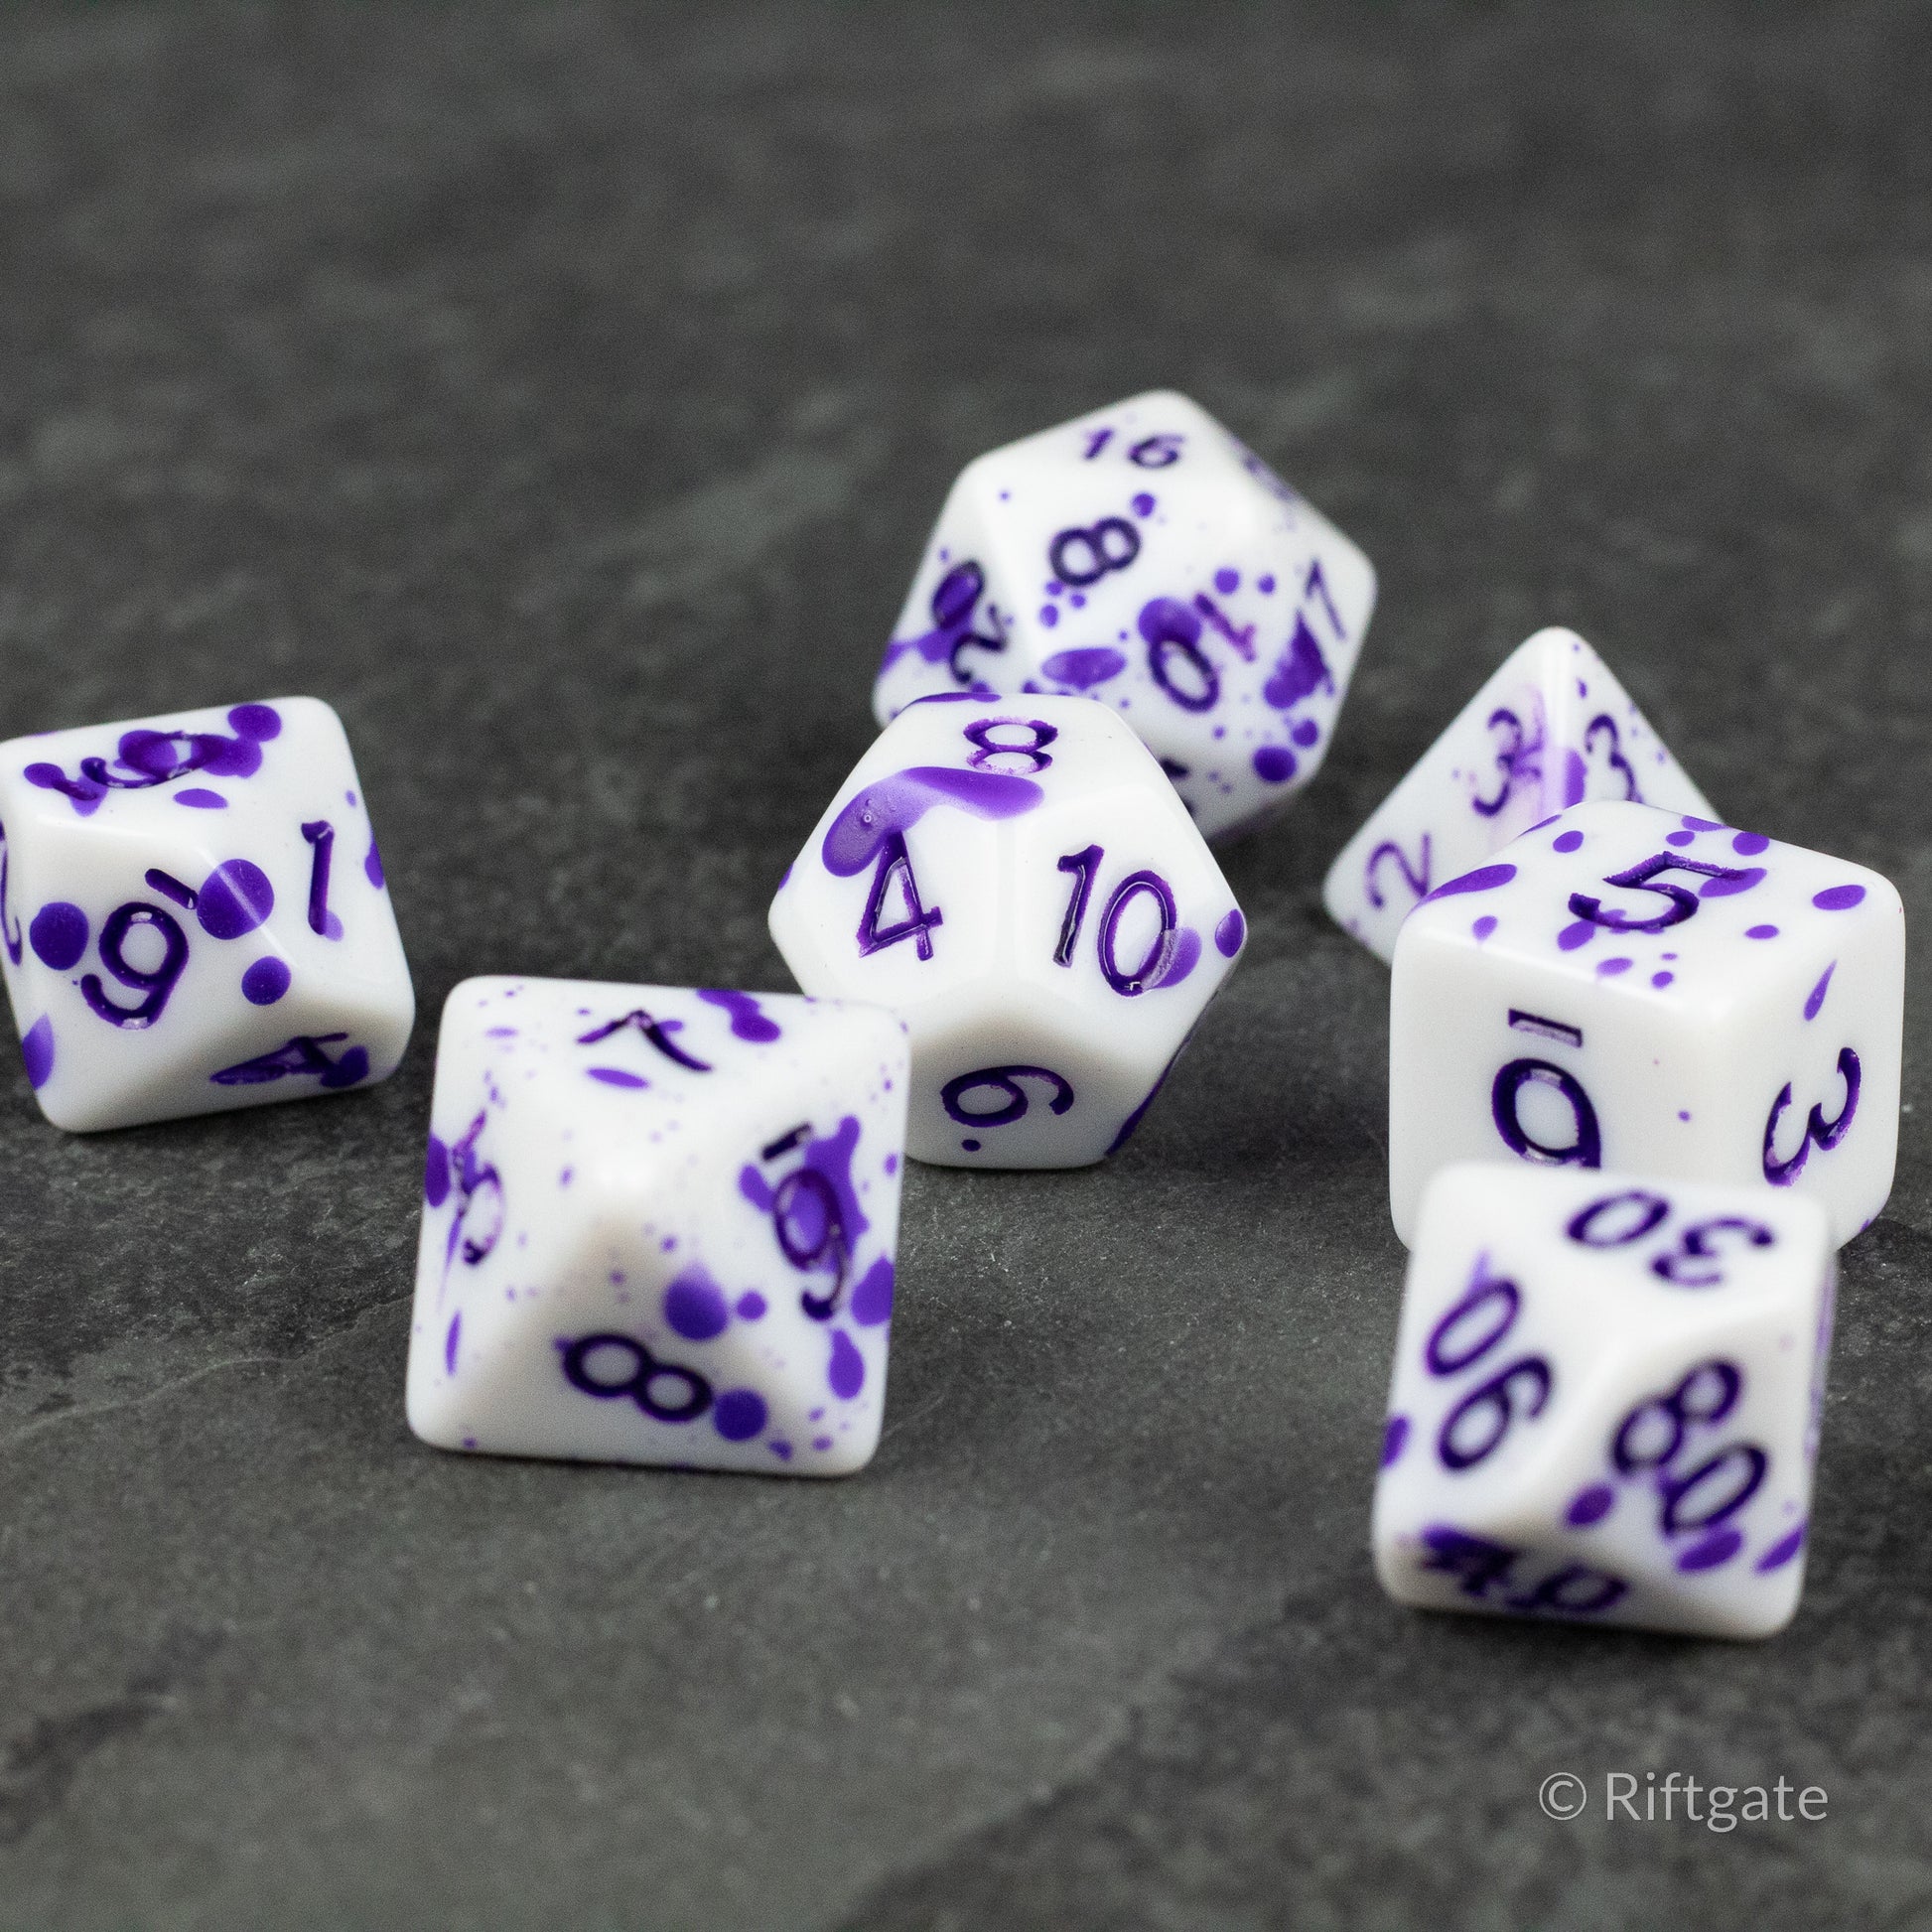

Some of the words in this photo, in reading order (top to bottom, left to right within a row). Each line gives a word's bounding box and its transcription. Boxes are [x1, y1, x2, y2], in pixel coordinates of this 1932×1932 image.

[1048, 516, 1141, 588] 8
[963, 716, 1058, 774] 8
[301, 820, 334, 935] 1
[857, 829, 943, 961] 4
[1053, 844, 1177, 997] 10
[1569, 850, 1745, 930] 5
[1763, 1046, 1862, 1188] 3
[1566, 1189, 1775, 1289] 30
[563, 1332, 714, 1424] 8
[1610, 1356, 1768, 1539] 80
